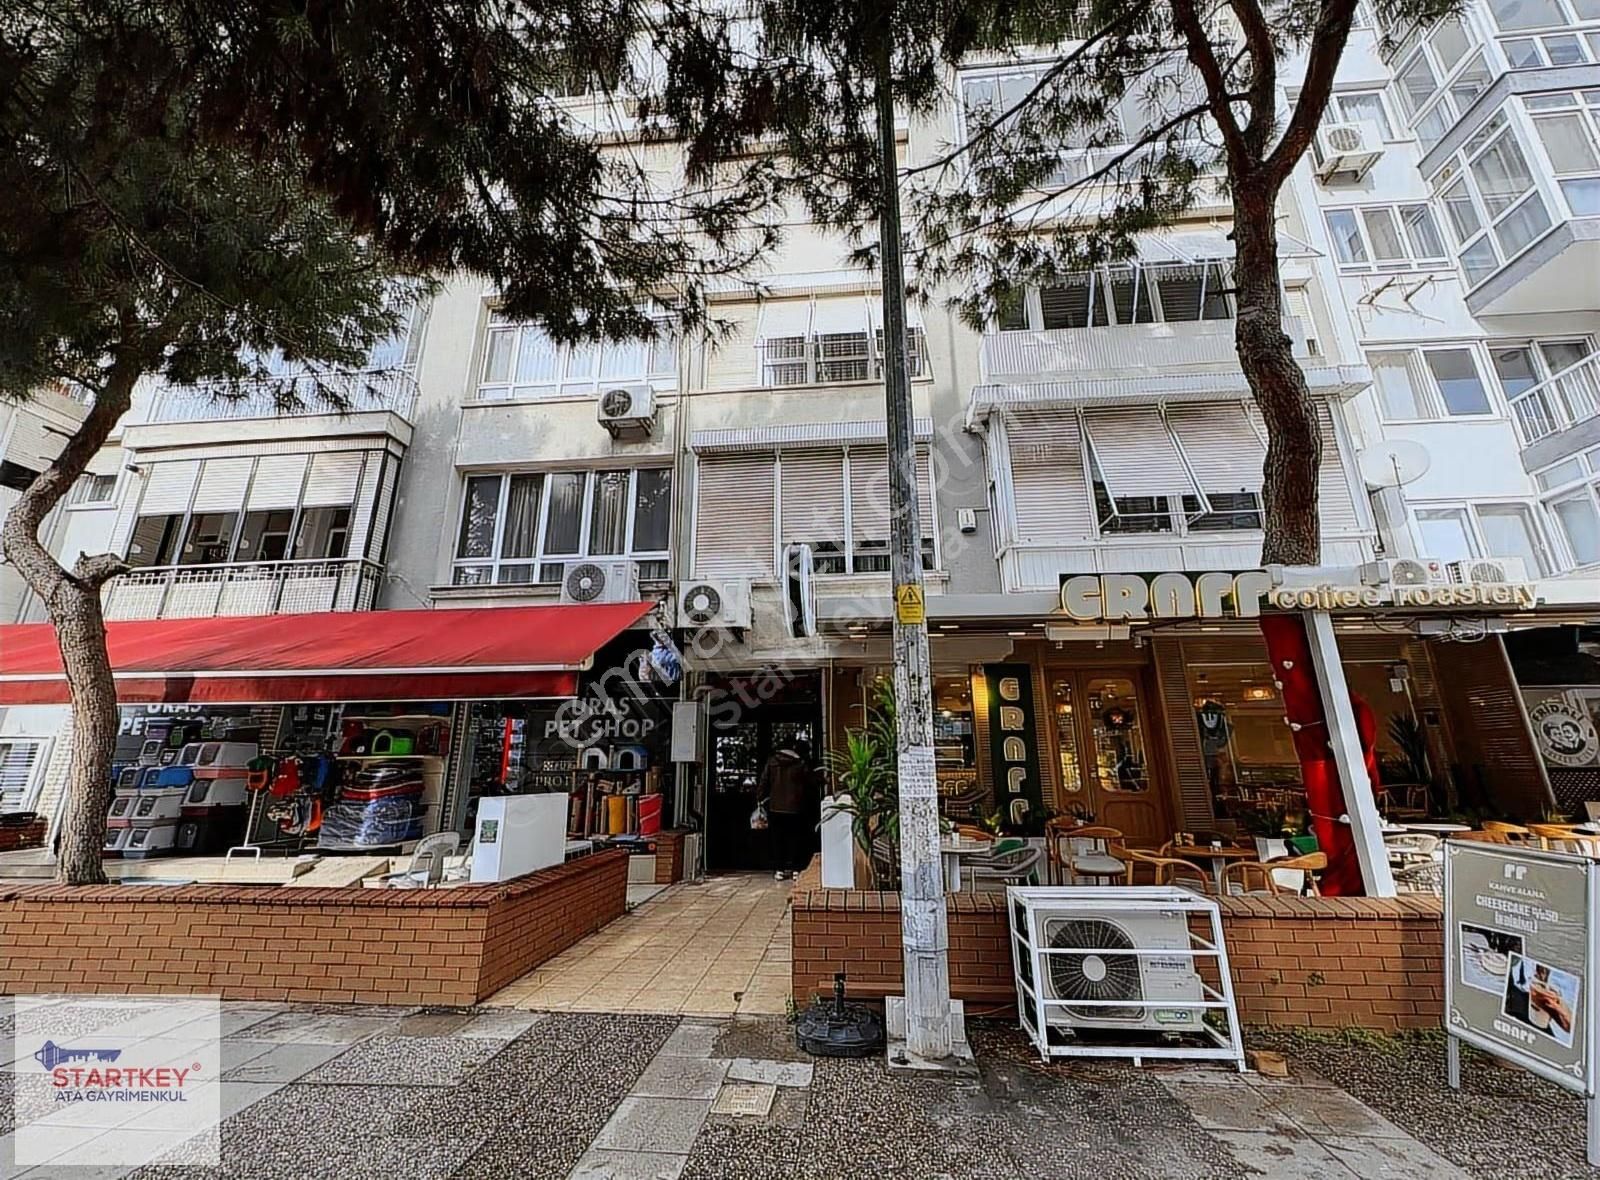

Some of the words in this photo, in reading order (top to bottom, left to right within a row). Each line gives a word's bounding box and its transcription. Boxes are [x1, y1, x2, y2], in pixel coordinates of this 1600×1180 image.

[572, 697, 631, 716] URAS
[544, 719, 582, 738] PET
[592, 718, 655, 738] SHOP
